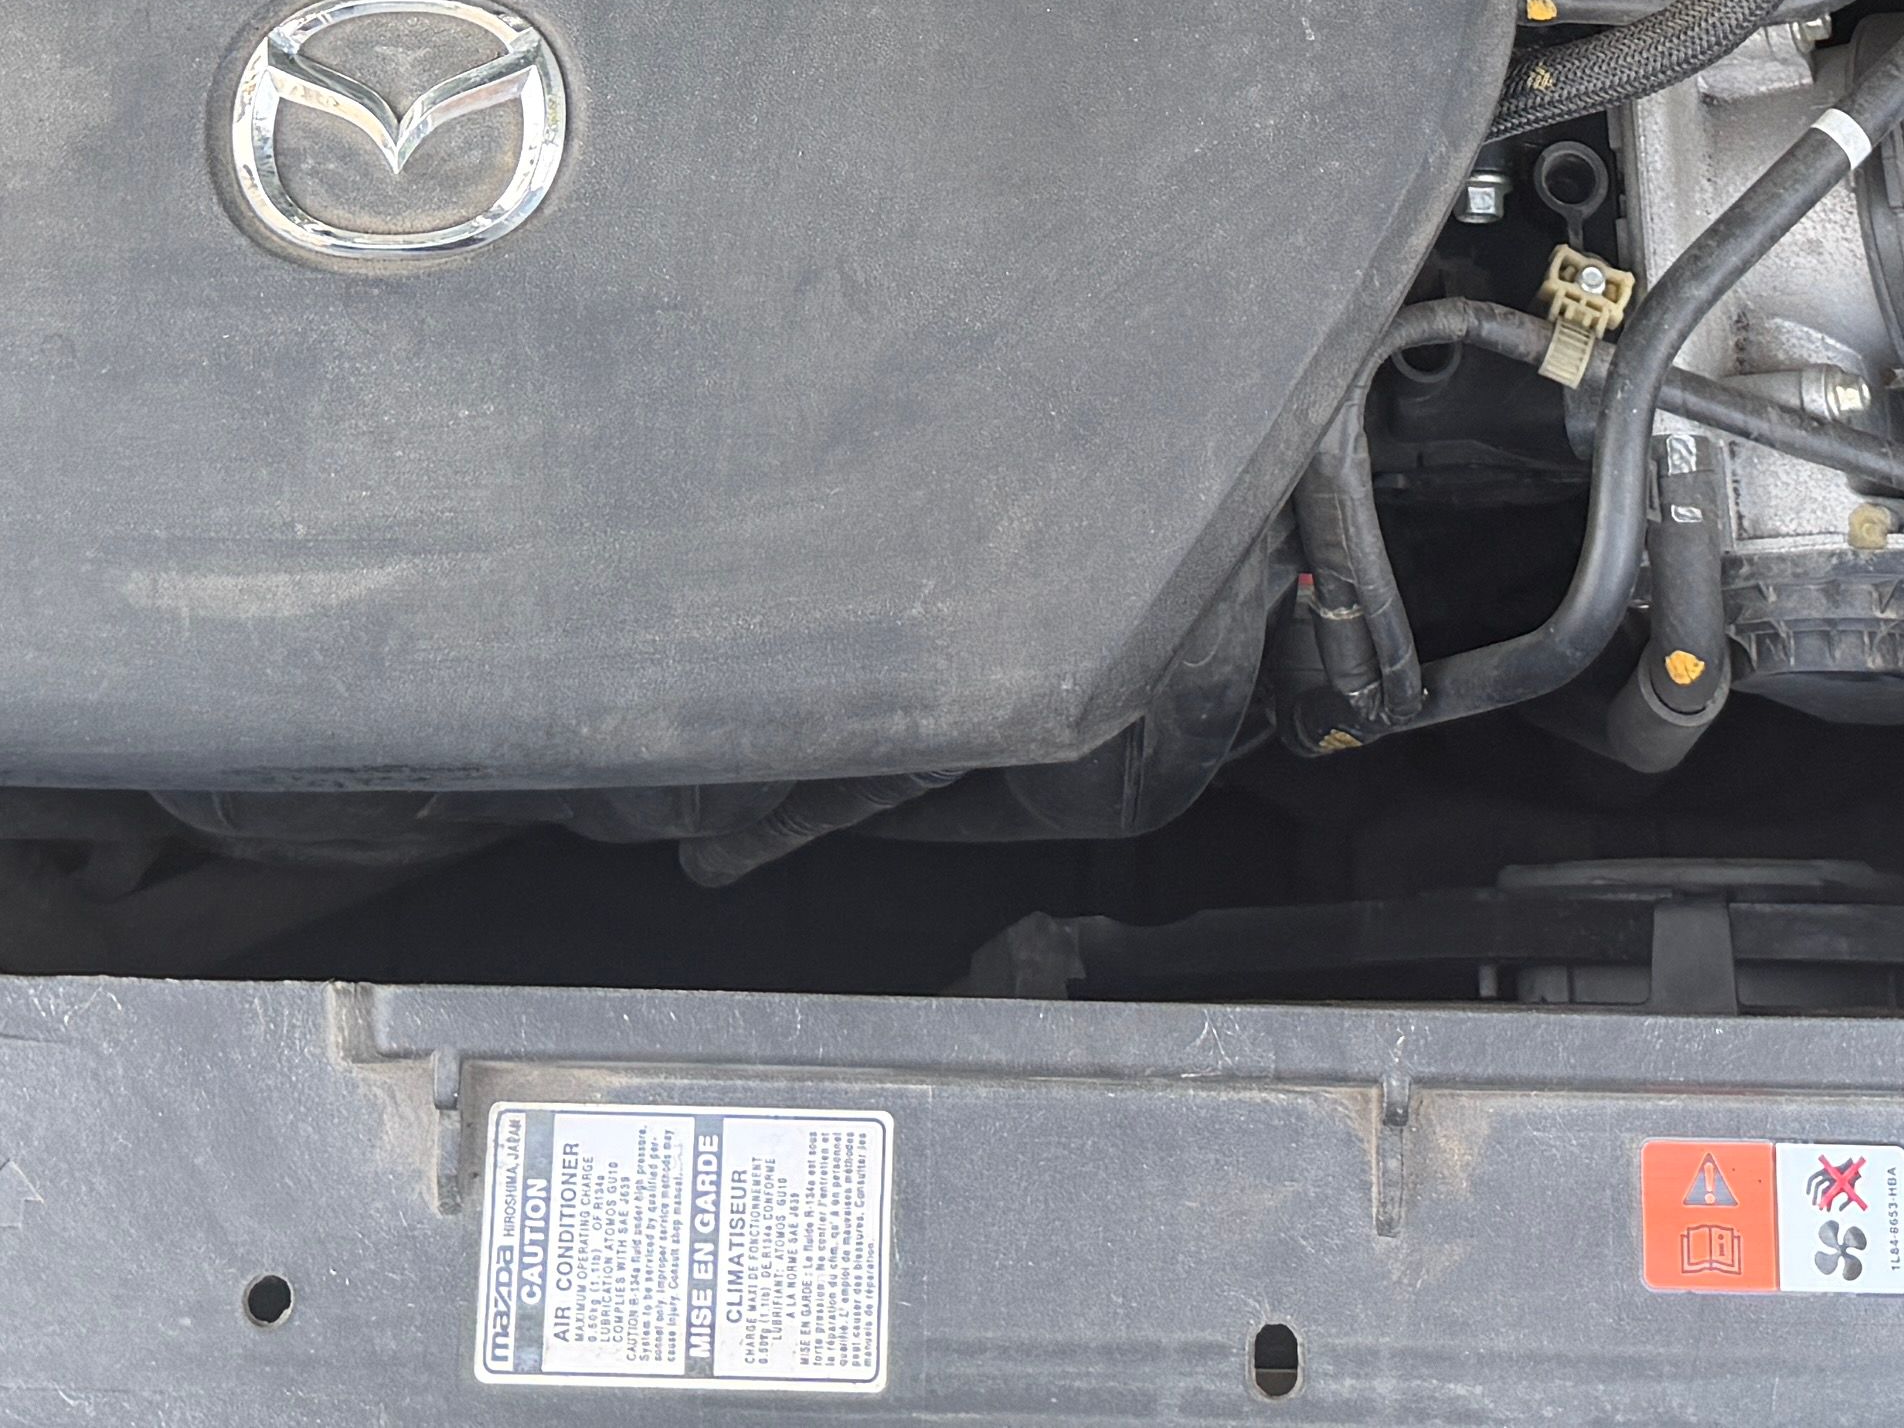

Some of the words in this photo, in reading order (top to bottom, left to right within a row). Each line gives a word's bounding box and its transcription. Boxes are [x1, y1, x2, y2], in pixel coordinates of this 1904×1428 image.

[581, 1155, 592, 1205] CHARGE
[694, 1134, 718, 1233] GARDE
[763, 1157, 774, 1220] CONFORME
[556, 1142, 578, 1291] CONDITIONER
[592, 1215, 601, 1230] OF
[604, 1199, 615, 1250] ATOMOS
[618, 1210, 628, 1233] SAE
[748, 1156, 761, 1260] FONCTIONNEMENT
[520, 1178, 547, 1304] CAUTION
[577, 1210, 590, 1279] OPERATING
[616, 1239, 626, 1270] WITH
[726, 1169, 747, 1323] CLIMATISEUR
[775, 1214, 785, 1259] ATOMOS
[788, 1222, 797, 1243] SAE
[491, 1245, 513, 1361] mazda
[503, 1162, 519, 1236] HIROSHIMA,
[692, 1242, 713, 1279] EN
[747, 1265, 757, 1279] DE
[786, 1248, 796, 1288] NORME
[574, 1284, 585, 1341] MAXIMUM
[600, 1256, 613, 1342] LUBRICATION
[613, 1276, 625, 1342] COMPLIES
[746, 1284, 756, 1311] MAXI
[786, 1293, 795, 1306] LA
[801, 1279, 811, 1316] GARDE
[554, 1306, 570, 1341] AIR
[626, 1309, 638, 1360] CAUTION
[689, 1288, 711, 1357] MISE
[744, 1317, 755, 1363] CHARGE
[800, 1321, 809, 1334] EN
[799, 1339, 809, 1364] MISE
